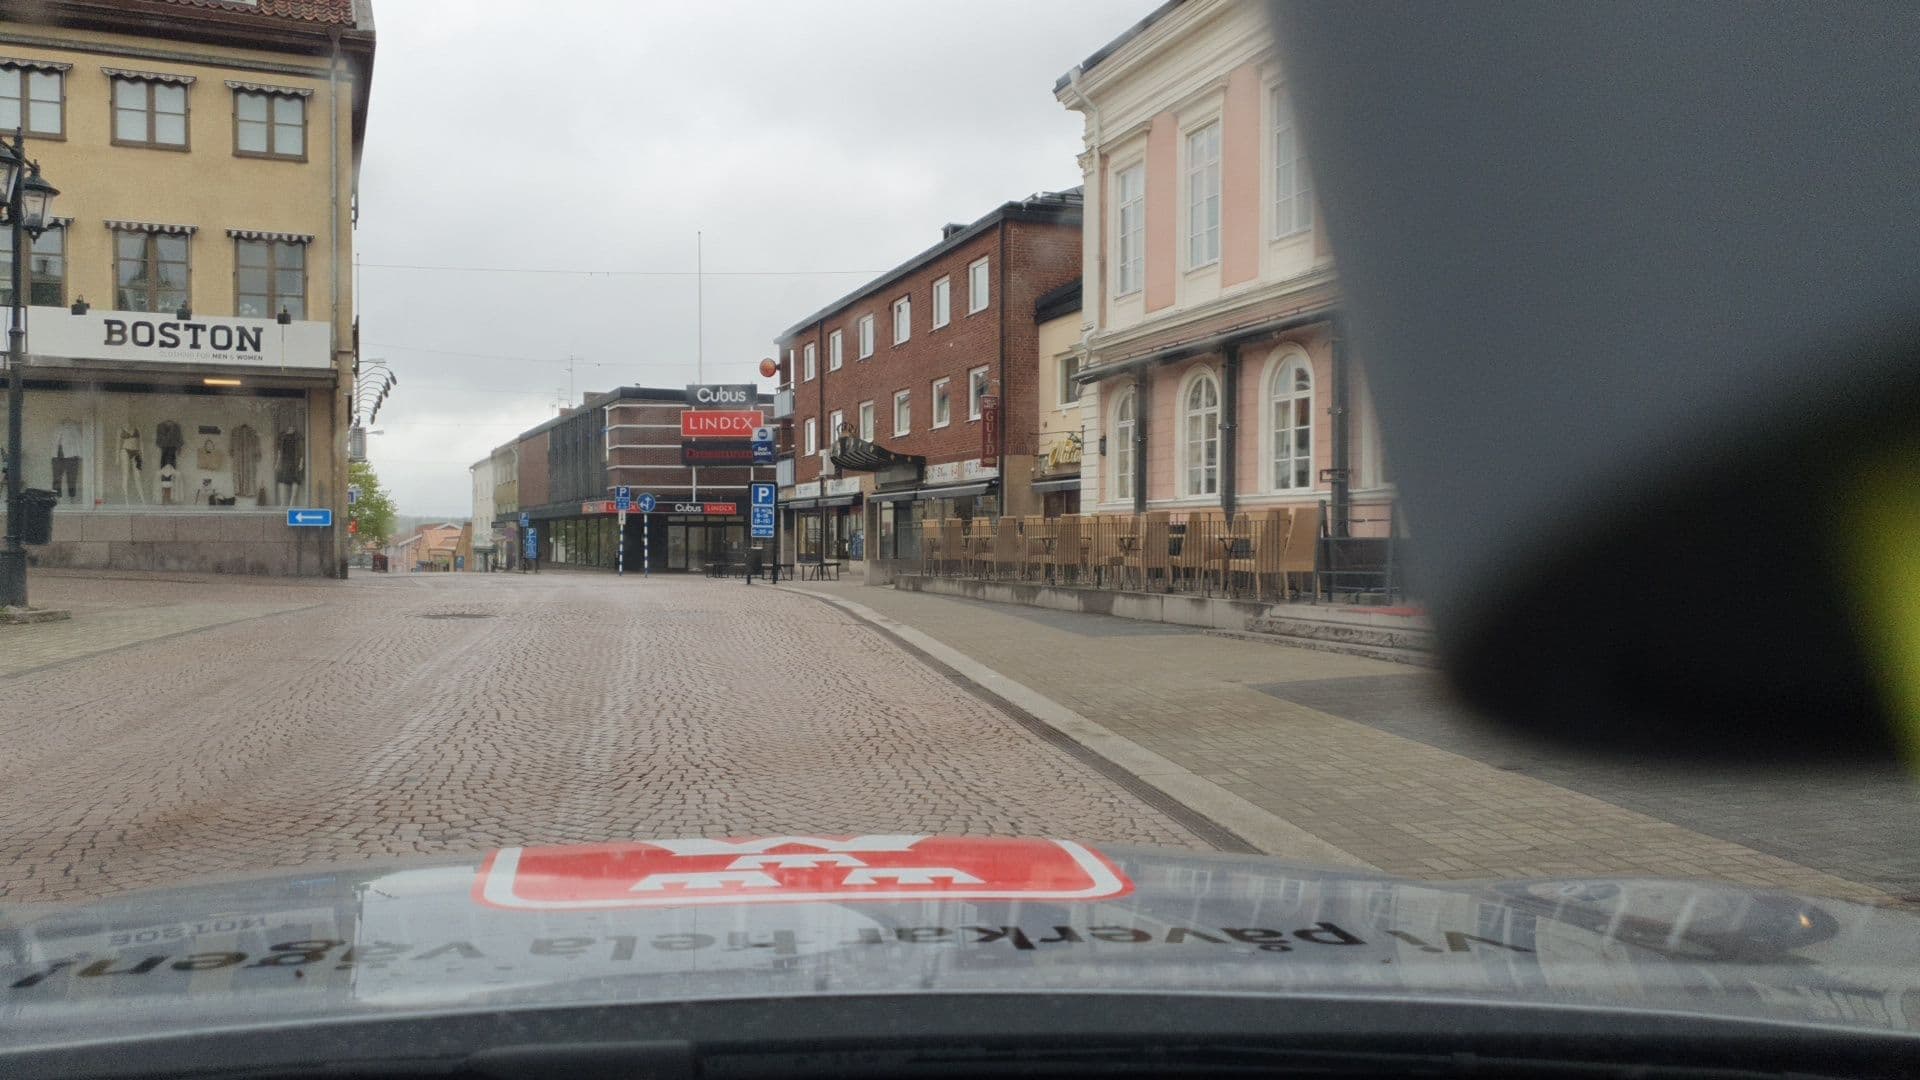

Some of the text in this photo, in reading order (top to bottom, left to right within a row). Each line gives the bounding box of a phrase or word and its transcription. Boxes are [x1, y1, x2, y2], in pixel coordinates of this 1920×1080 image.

[104, 319, 263, 352] BOSTON
[697, 386, 746, 403] Cubus
[689, 416, 753, 430] LINDEX
[619, 488, 627, 496] P
[758, 487, 770, 502] P
[675, 503, 702, 512] Cubus
